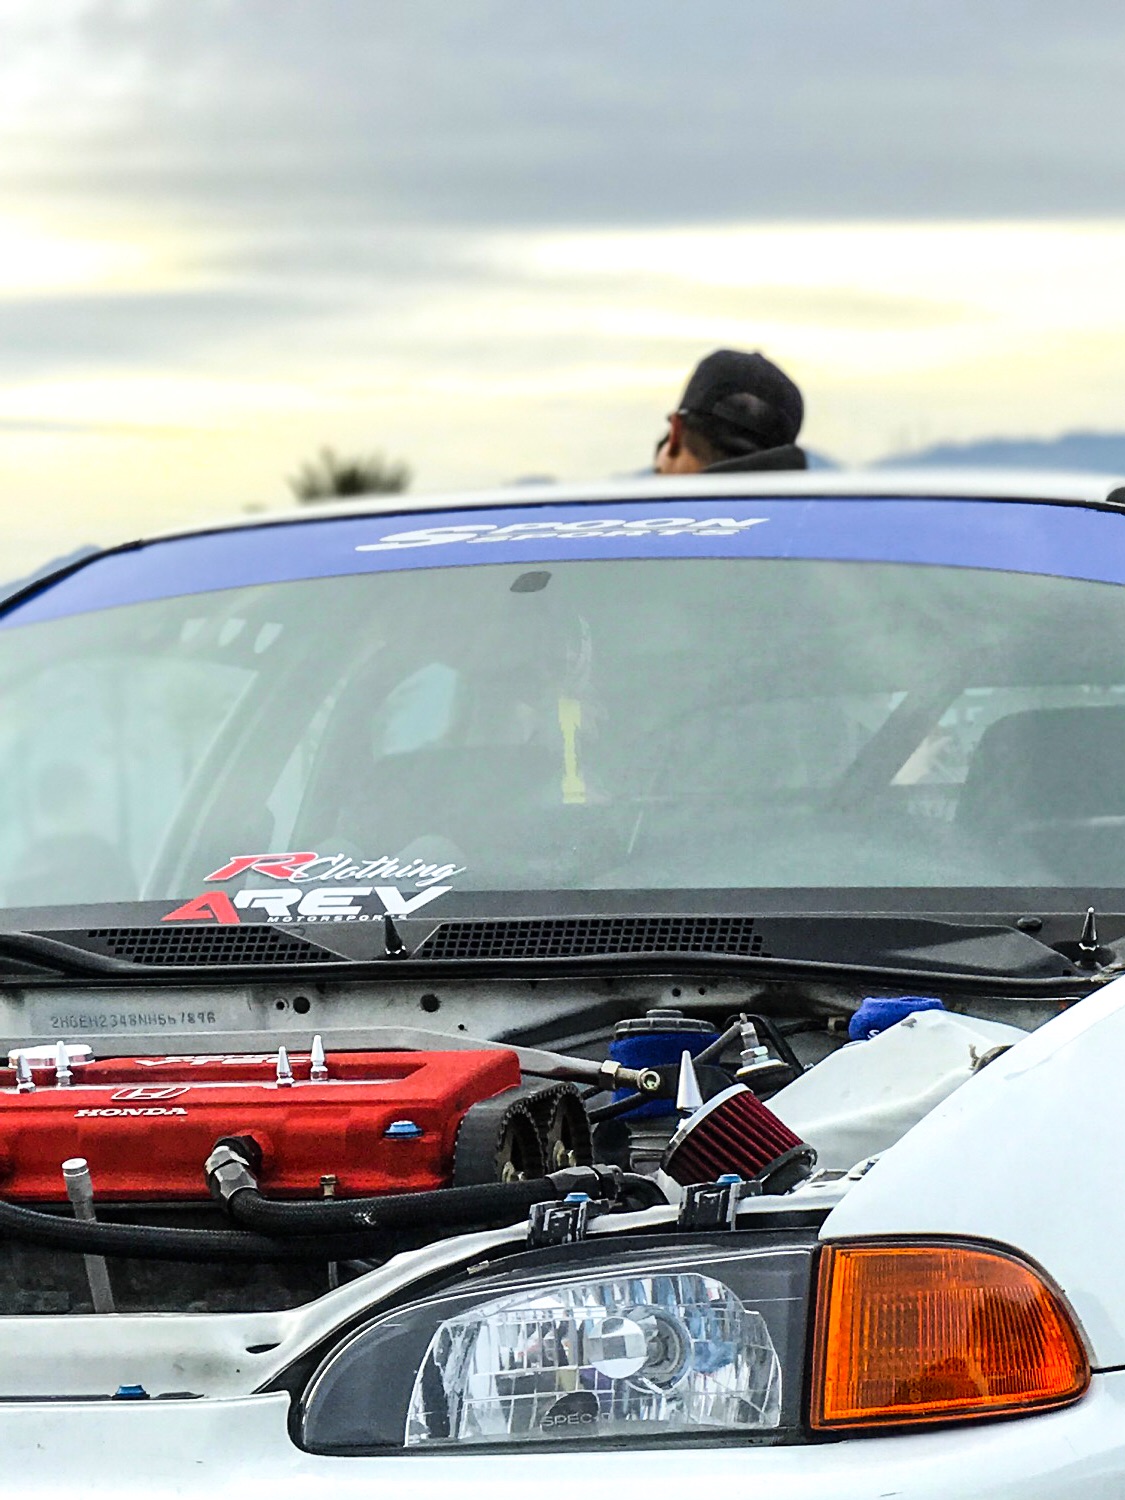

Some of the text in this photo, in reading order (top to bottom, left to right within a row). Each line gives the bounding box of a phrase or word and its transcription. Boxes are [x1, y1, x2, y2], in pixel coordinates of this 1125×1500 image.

[355, 518, 770, 552] SPOON
[287, 853, 467, 887] Clothing
[160, 886, 453, 925] AREV
[74, 1107, 188, 1118] HONDA
